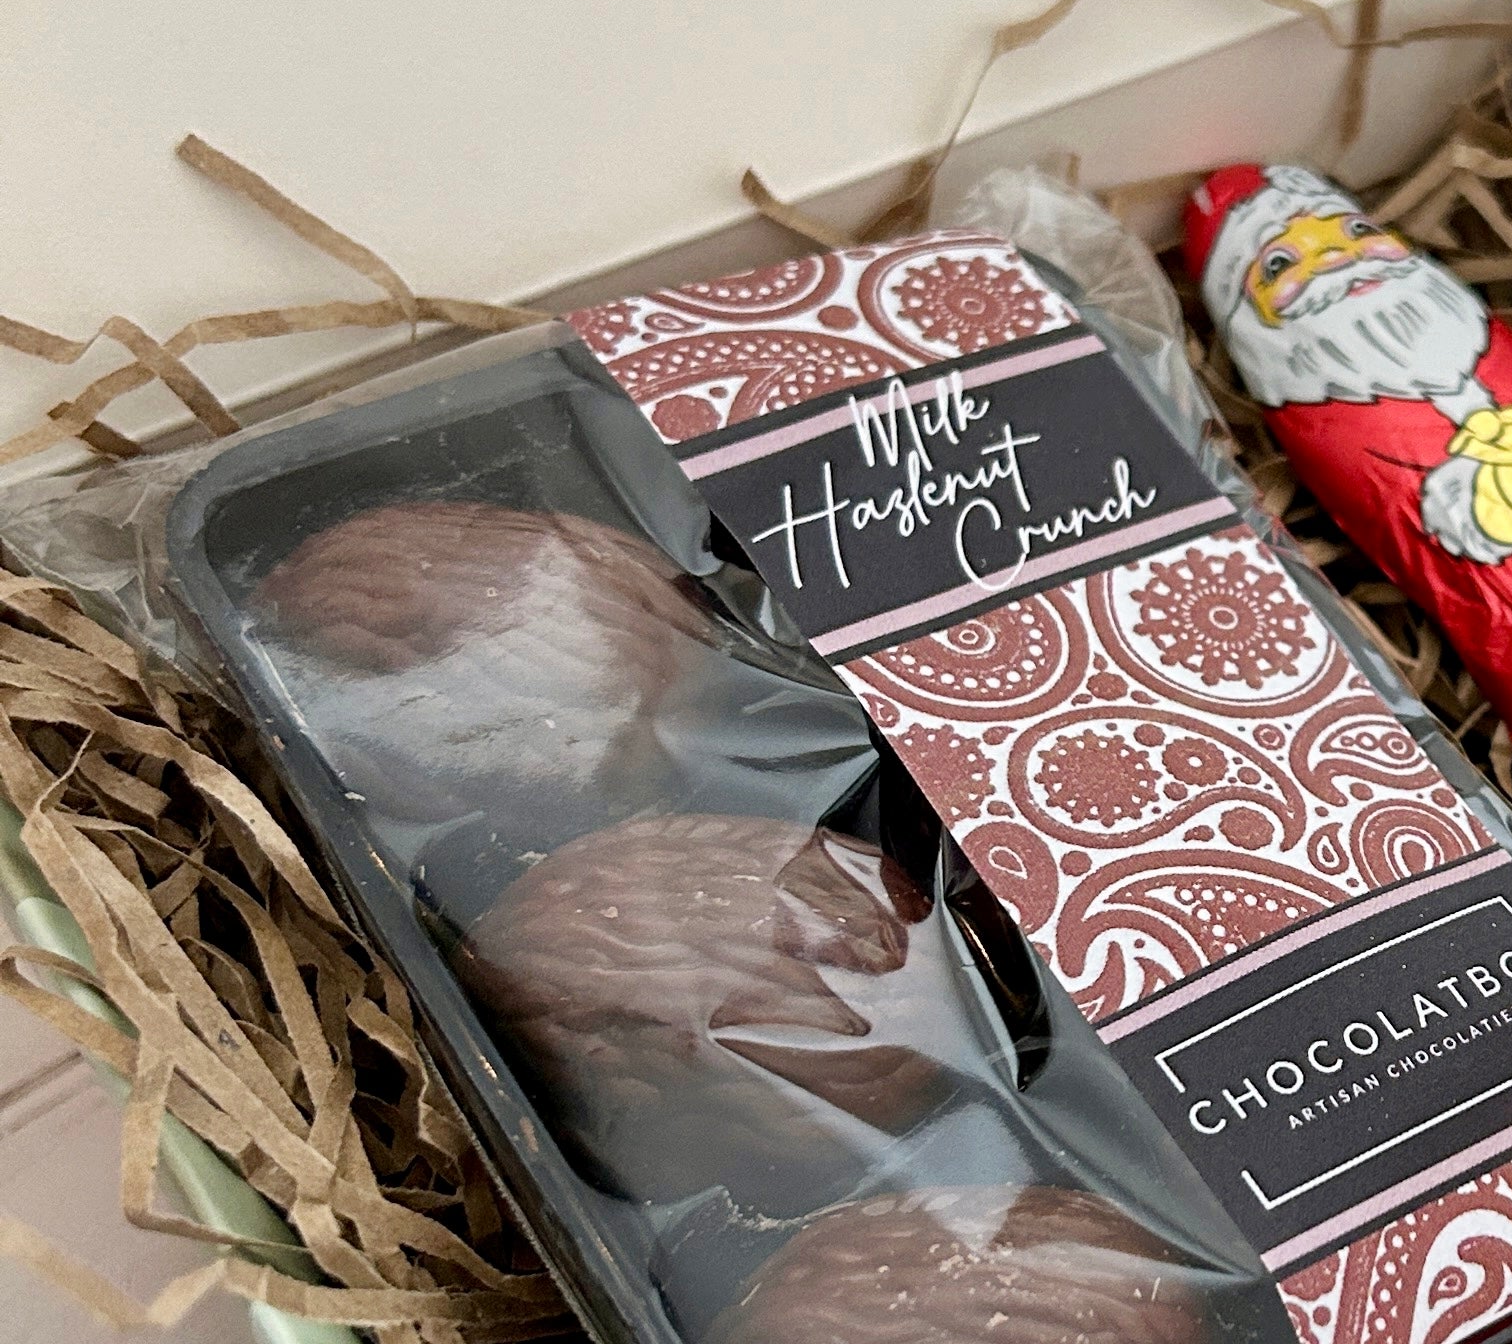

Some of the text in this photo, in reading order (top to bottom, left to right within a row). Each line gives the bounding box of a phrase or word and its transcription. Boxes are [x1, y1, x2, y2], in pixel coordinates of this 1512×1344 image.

[848, 370, 990, 471] Milk
[956, 457, 1156, 592] Crunch
[1288, 1074, 1381, 1130] ARTISAN
